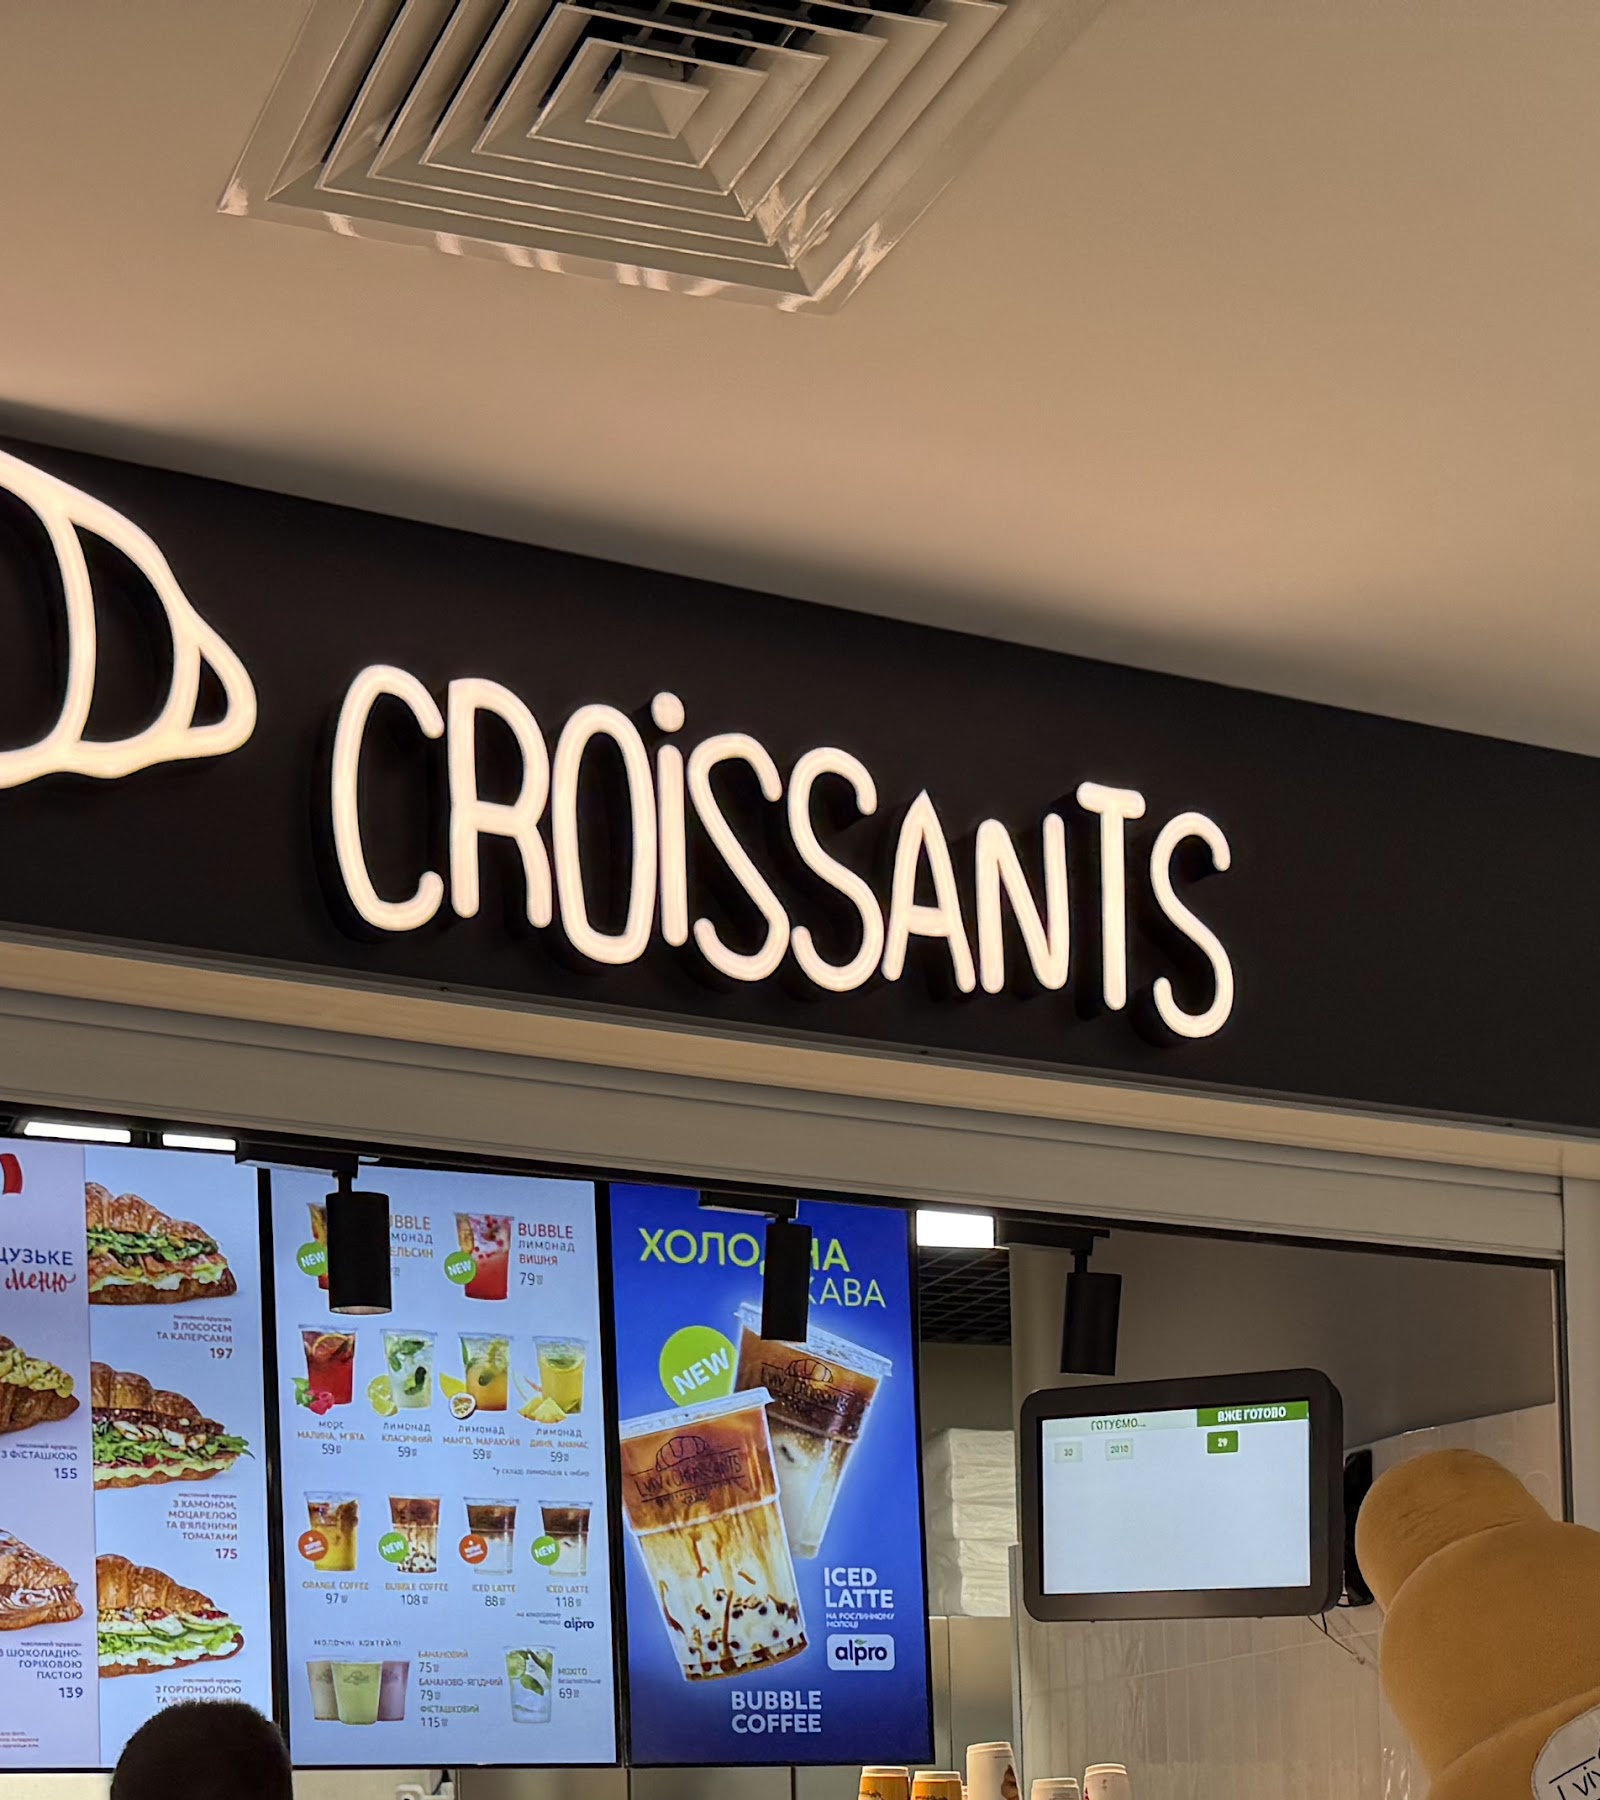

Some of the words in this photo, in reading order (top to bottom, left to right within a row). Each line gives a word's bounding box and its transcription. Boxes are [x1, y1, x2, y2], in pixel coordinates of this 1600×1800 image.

[331, 664, 1234, 1039] CROISSANTS
[518, 1223, 574, 1239] BUBBLE
[518, 1239, 575, 1253] лимонад
[300, 1252, 326, 1268] NEW
[519, 1254, 558, 1266] ВИШНЯ
[447, 1260, 472, 1276] NEW
[520, 1272, 535, 1286] 79
[209, 1348, 233, 1359] 197
[672, 1347, 730, 1396] NEW
[1243, 1406, 1287, 1420] ГОТОВО
[54, 1468, 78, 1479] 155
[215, 1548, 237, 1560] 175
[824, 1567, 877, 1587] ICED
[401, 1594, 420, 1605] 108
[555, 1596, 574, 1607] 118
[825, 1589, 893, 1608] LATTE
[564, 1617, 594, 1632] alpro
[835, 1639, 887, 1666] alpro
[58, 1687, 83, 1698] 139
[731, 1691, 822, 1710] BUBBLE
[421, 1717, 440, 1728] 115
[731, 1714, 822, 1733] COFFEE
